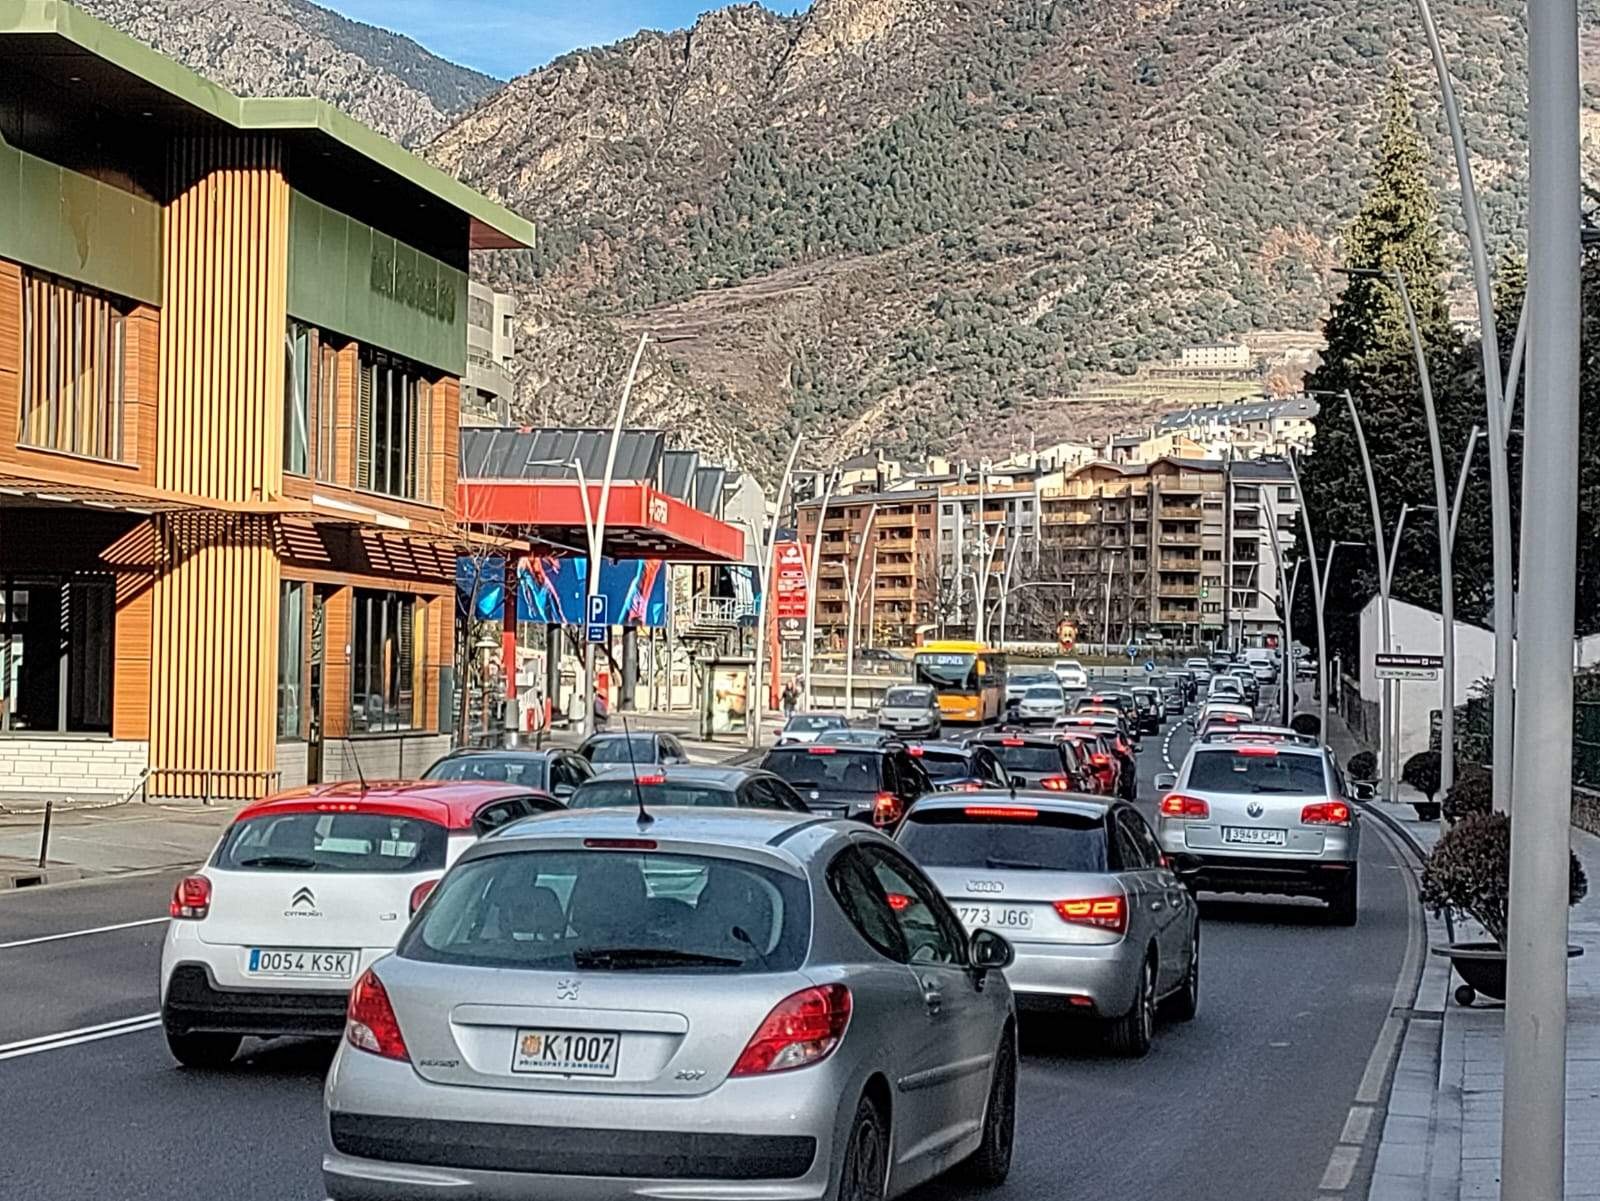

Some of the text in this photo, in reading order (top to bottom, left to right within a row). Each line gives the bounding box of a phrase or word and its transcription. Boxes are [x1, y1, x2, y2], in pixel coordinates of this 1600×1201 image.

[592, 598, 603, 621] P
[952, 907, 1029, 926] 773 JGG
[261, 953, 347, 972] 0054 KSK
